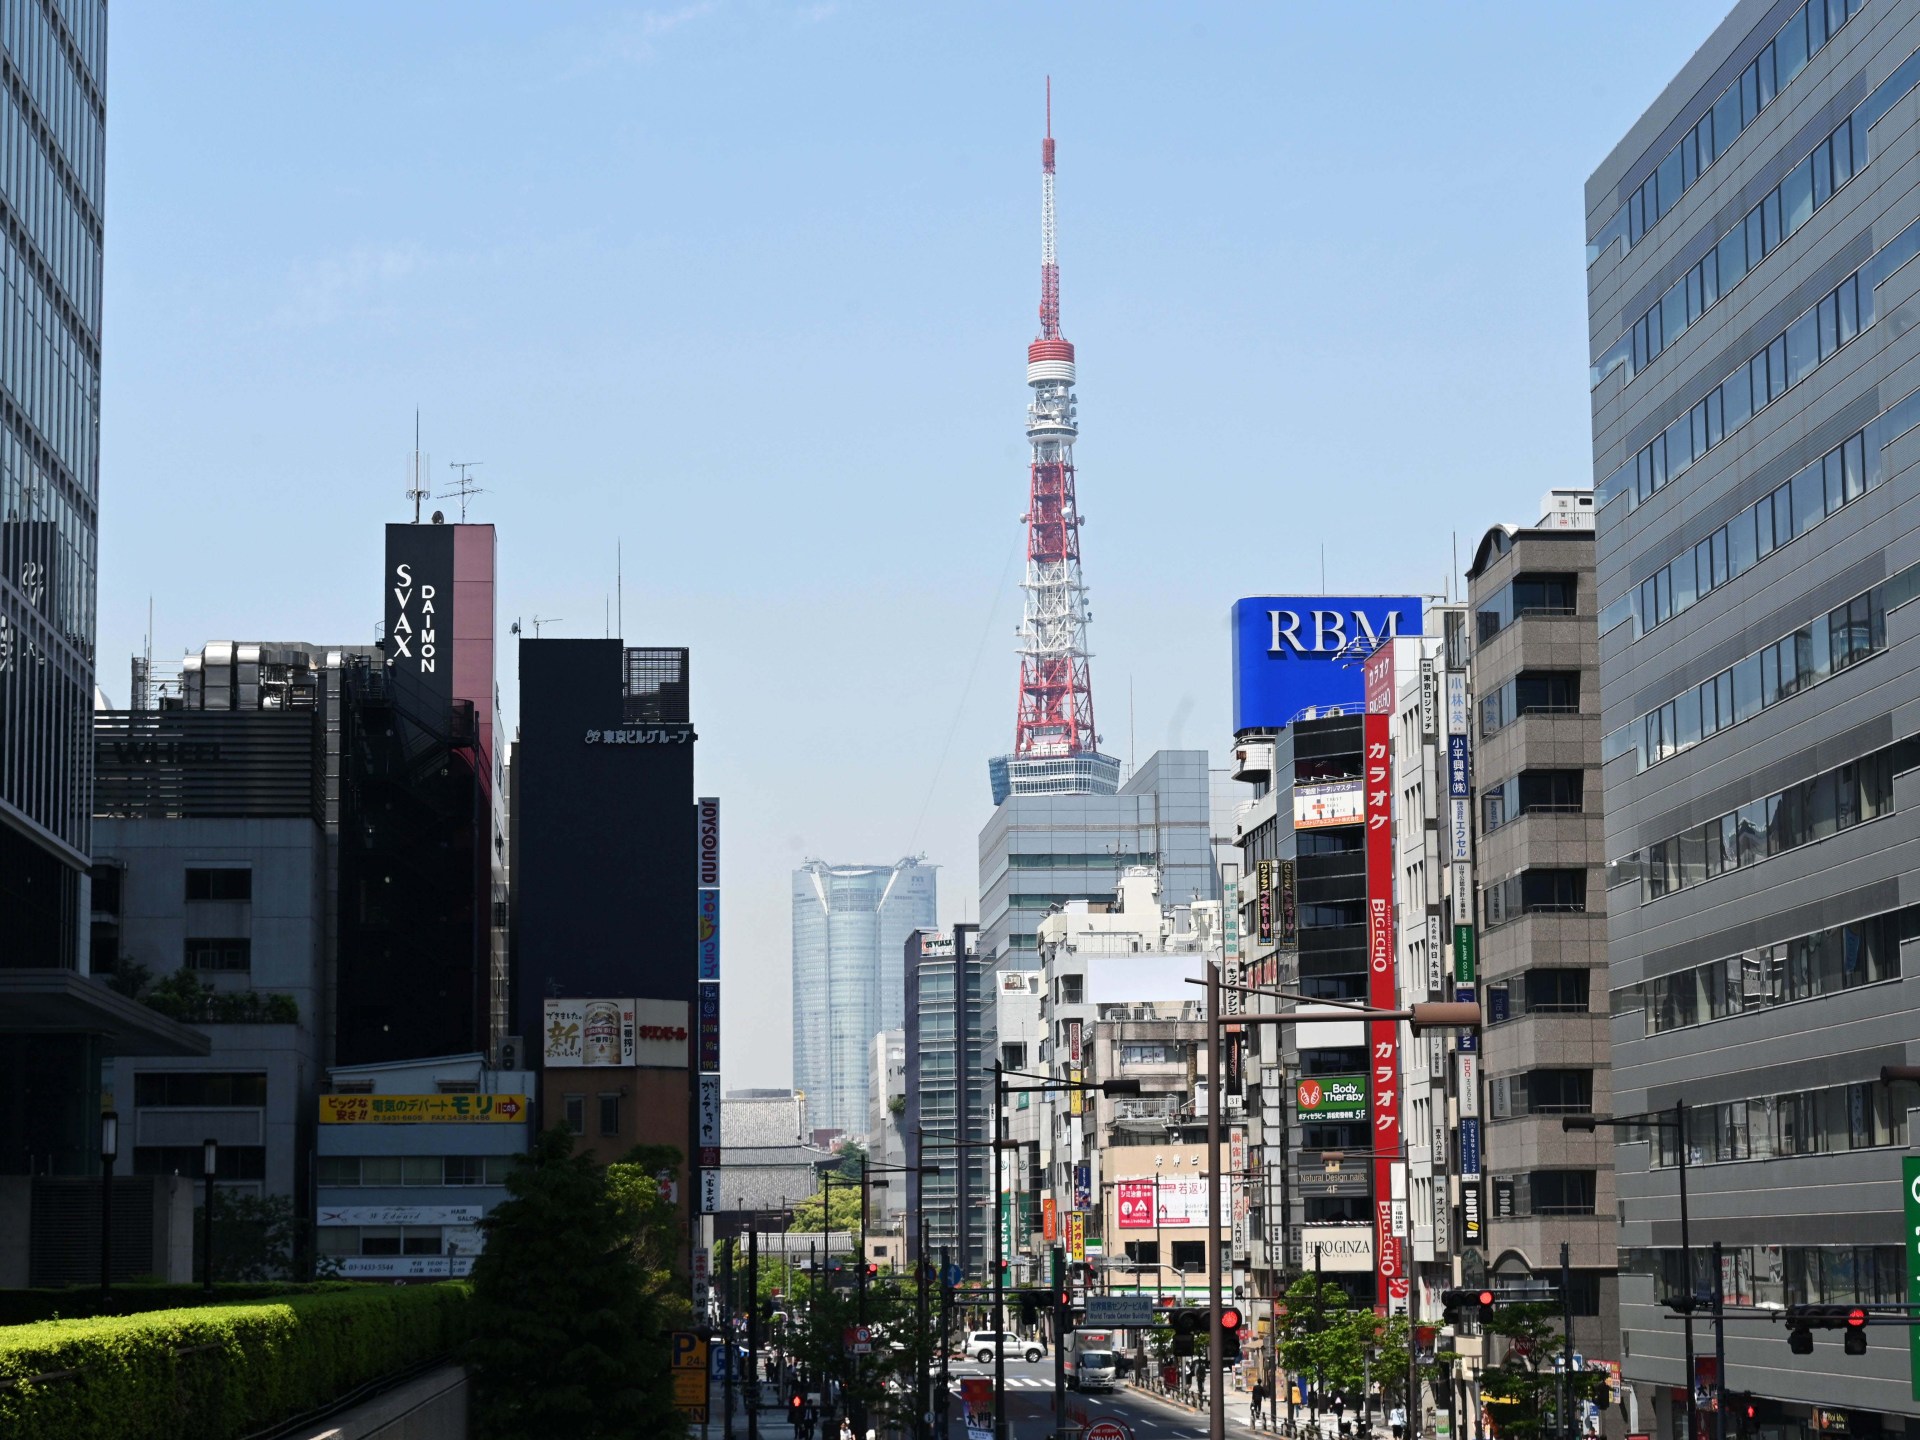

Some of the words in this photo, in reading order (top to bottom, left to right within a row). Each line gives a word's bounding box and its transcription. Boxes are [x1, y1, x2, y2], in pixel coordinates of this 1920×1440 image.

[393, 563, 413, 658] SVAX
[421, 585, 435, 673] DAIMON
[1266, 610, 1402, 651] RBM
[1369, 657, 1390, 688] カラオケ
[1423, 674, 1432, 730] 東京ロジマッチ
[603, 729, 690, 744] 東京ビルグループ
[1369, 743, 1389, 830] カラオケ
[701, 801, 717, 884] JOYSOUND
[1456, 821, 1466, 857] エクセル
[1371, 899, 1385, 928] BIG
[1373, 930, 1387, 973] ECHO
[1323, 1091, 1364, 1102] Therapy
[1332, 1083, 1358, 1095] Body
[1376, 1042, 1396, 1130] カラオケ
[328, 1097, 368, 1109] ビッグな
[451, 1096, 492, 1114] モリ
[1230, 1097, 1240, 1105] 3F
[1355, 1109, 1366, 1119] 5F
[1300, 1174, 1324, 1182] Natural
[1325, 1173, 1348, 1183] Design
[1326, 1184, 1338, 1194] 4F
[1074, 1223, 1082, 1250] メガネ
[1334, 1240, 1370, 1253] GINZA
[1381, 1234, 1395, 1275] ECHO
[674, 1334, 696, 1365] P
[967, 1412, 992, 1428] 大門
